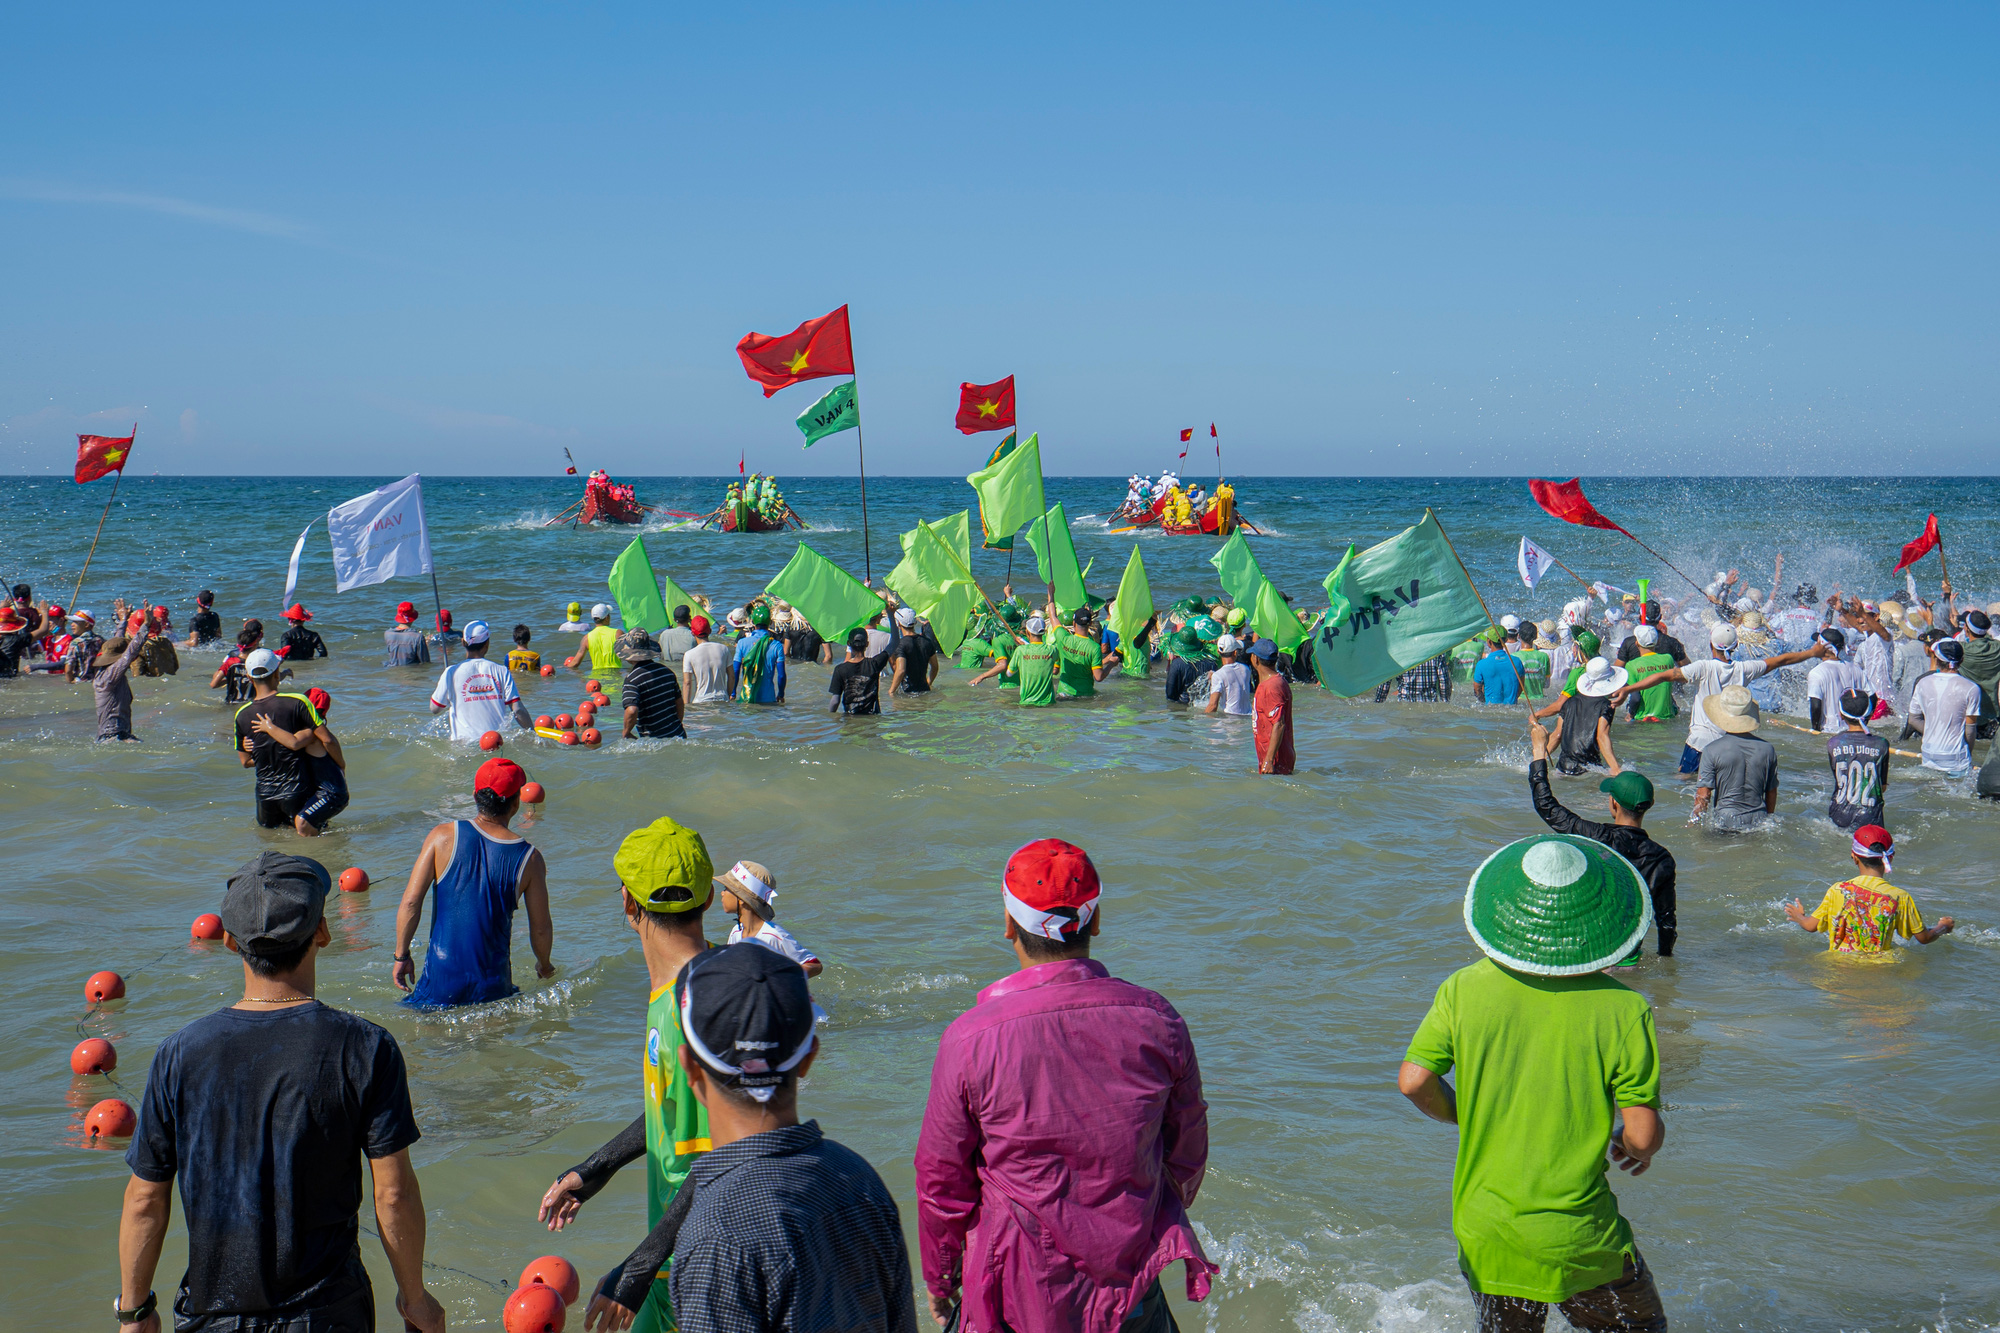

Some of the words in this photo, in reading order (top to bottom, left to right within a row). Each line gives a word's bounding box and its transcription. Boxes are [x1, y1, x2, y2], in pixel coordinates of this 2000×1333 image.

[846, 398, 855, 410] 4
[1856, 745, 1880, 757] Vlogs
[1835, 760, 1877, 807] 502
